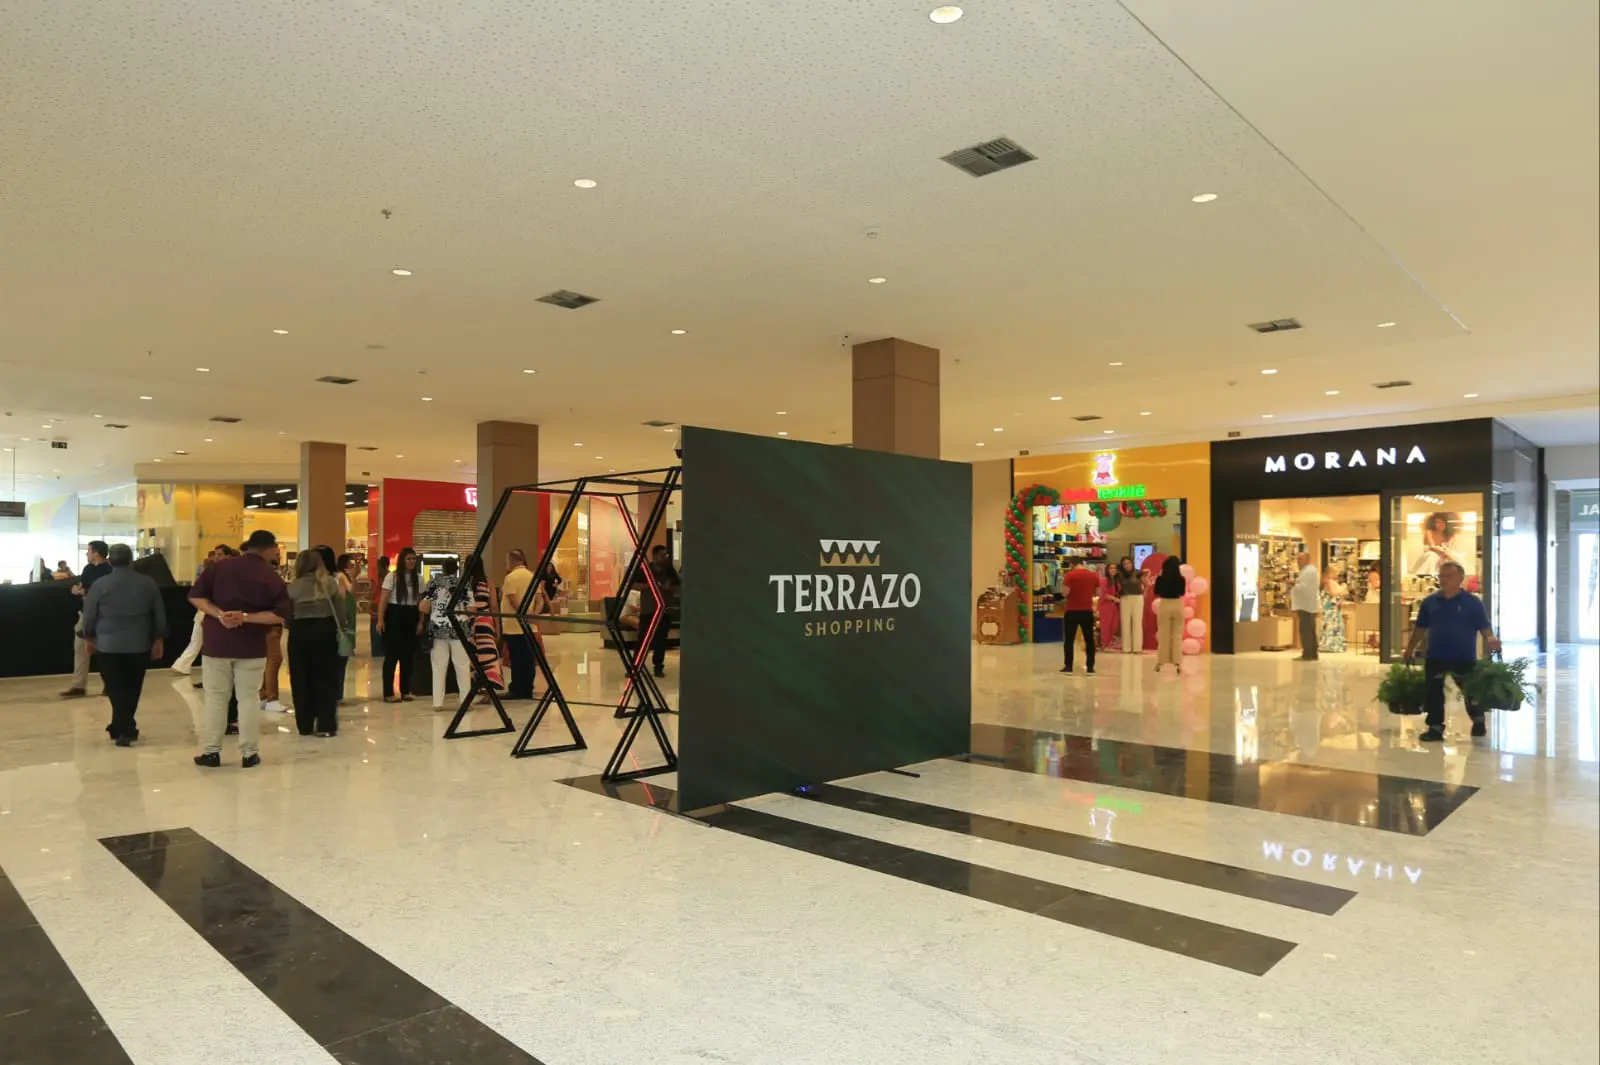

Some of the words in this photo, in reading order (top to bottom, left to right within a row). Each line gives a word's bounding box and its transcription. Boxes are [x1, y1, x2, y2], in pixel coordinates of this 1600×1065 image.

[1264, 445, 1426, 473] MORANA
[768, 572, 921, 613] TERRAZO
[804, 617, 895, 637] SHOPPING
